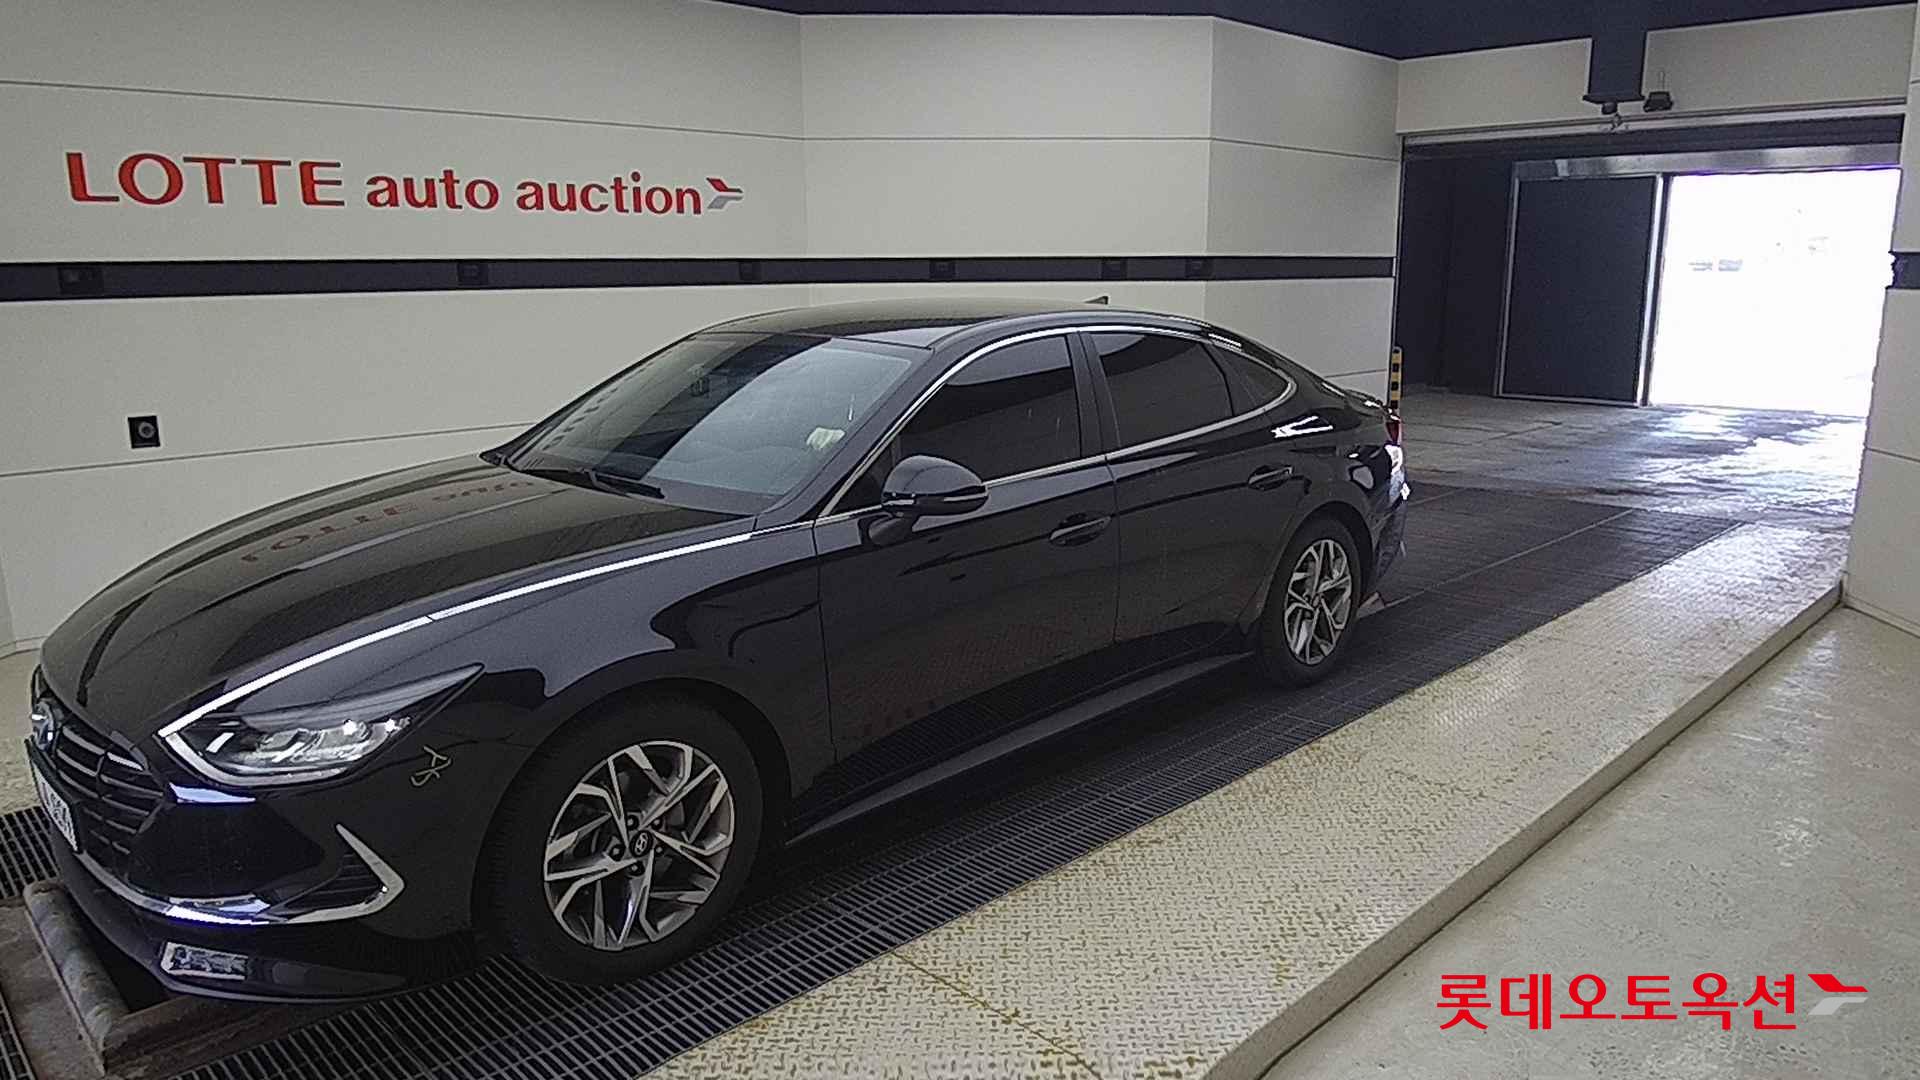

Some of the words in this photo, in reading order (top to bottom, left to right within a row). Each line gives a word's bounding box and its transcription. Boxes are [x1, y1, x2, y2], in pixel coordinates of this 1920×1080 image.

[66, 153, 345, 207] LOTTE
[366, 169, 500, 210] auto
[516, 171, 704, 214] auction
